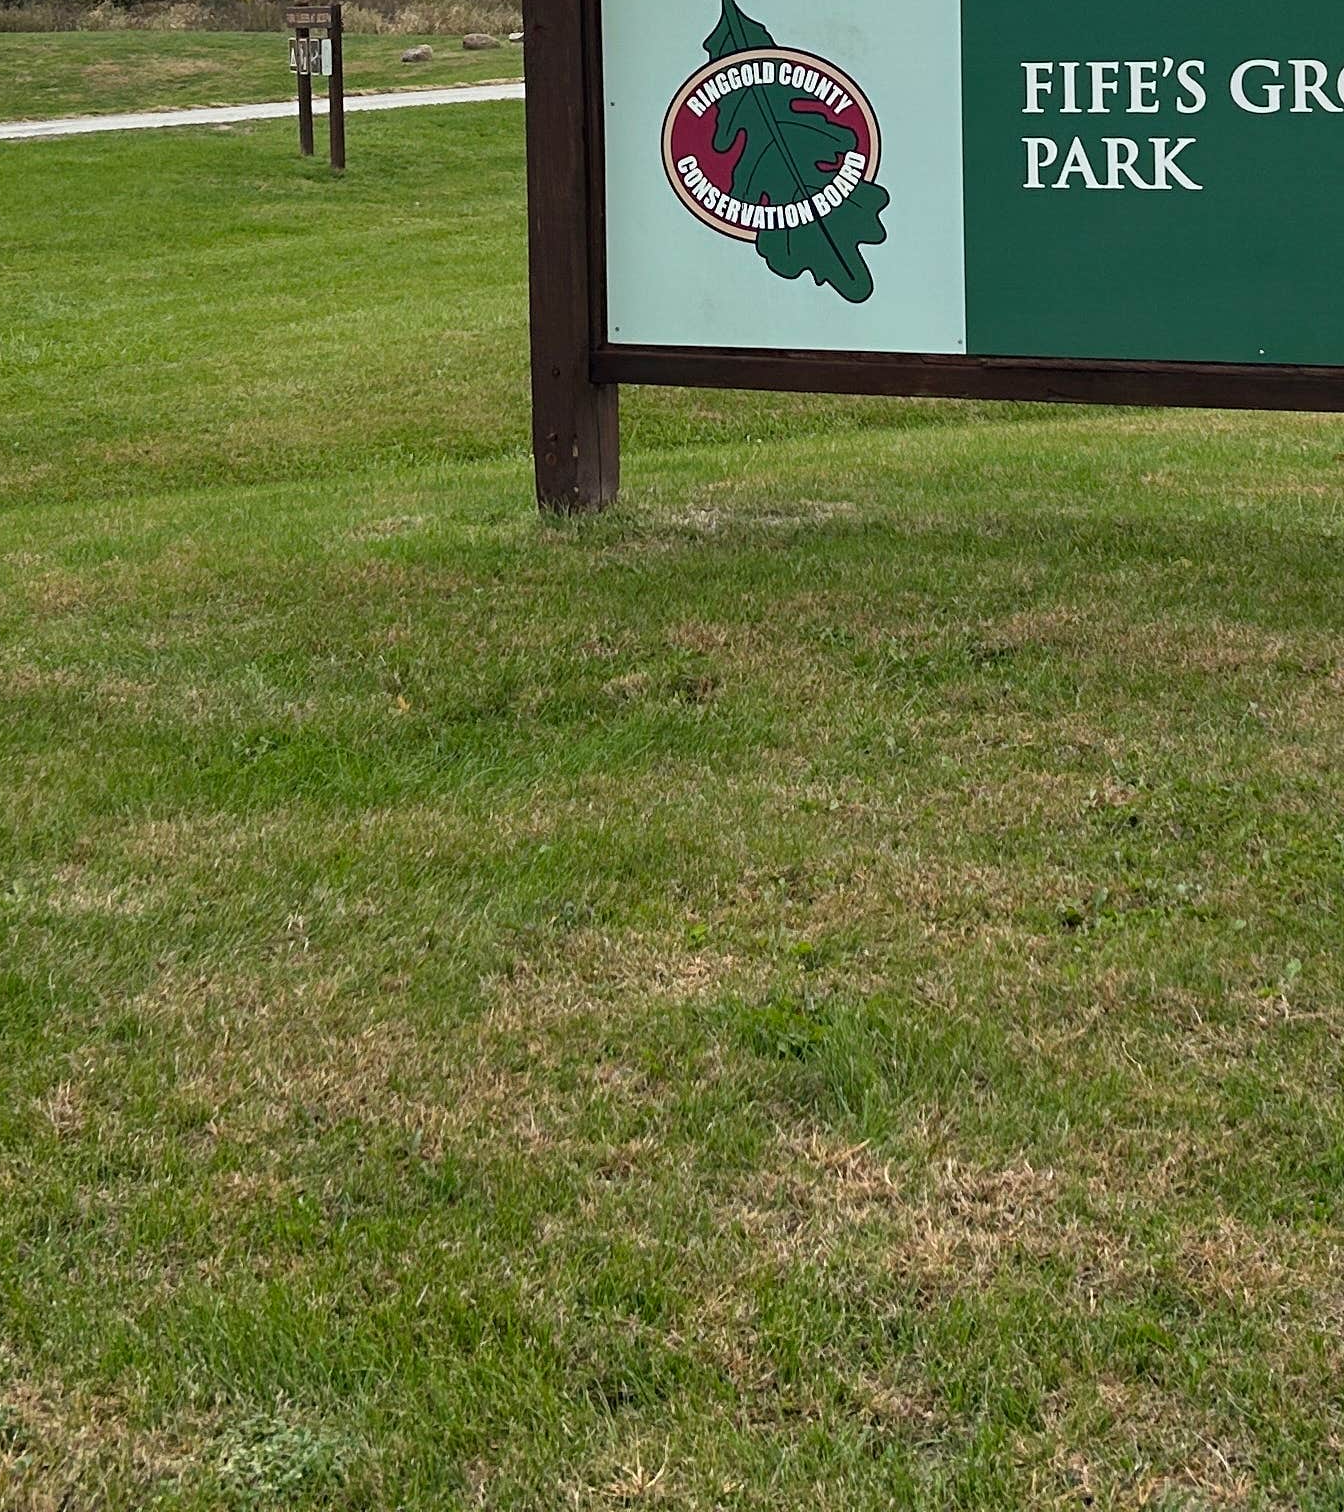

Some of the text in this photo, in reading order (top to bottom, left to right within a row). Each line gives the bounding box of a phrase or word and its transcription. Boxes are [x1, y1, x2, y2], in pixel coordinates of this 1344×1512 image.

[686, 61, 853, 117] RINGGOLD COUNTY
[1021, 57, 1206, 114] FIFE'S
[677, 151, 866, 230] CONSERVATION BOARD
[1022, 136, 1203, 190] PARK
